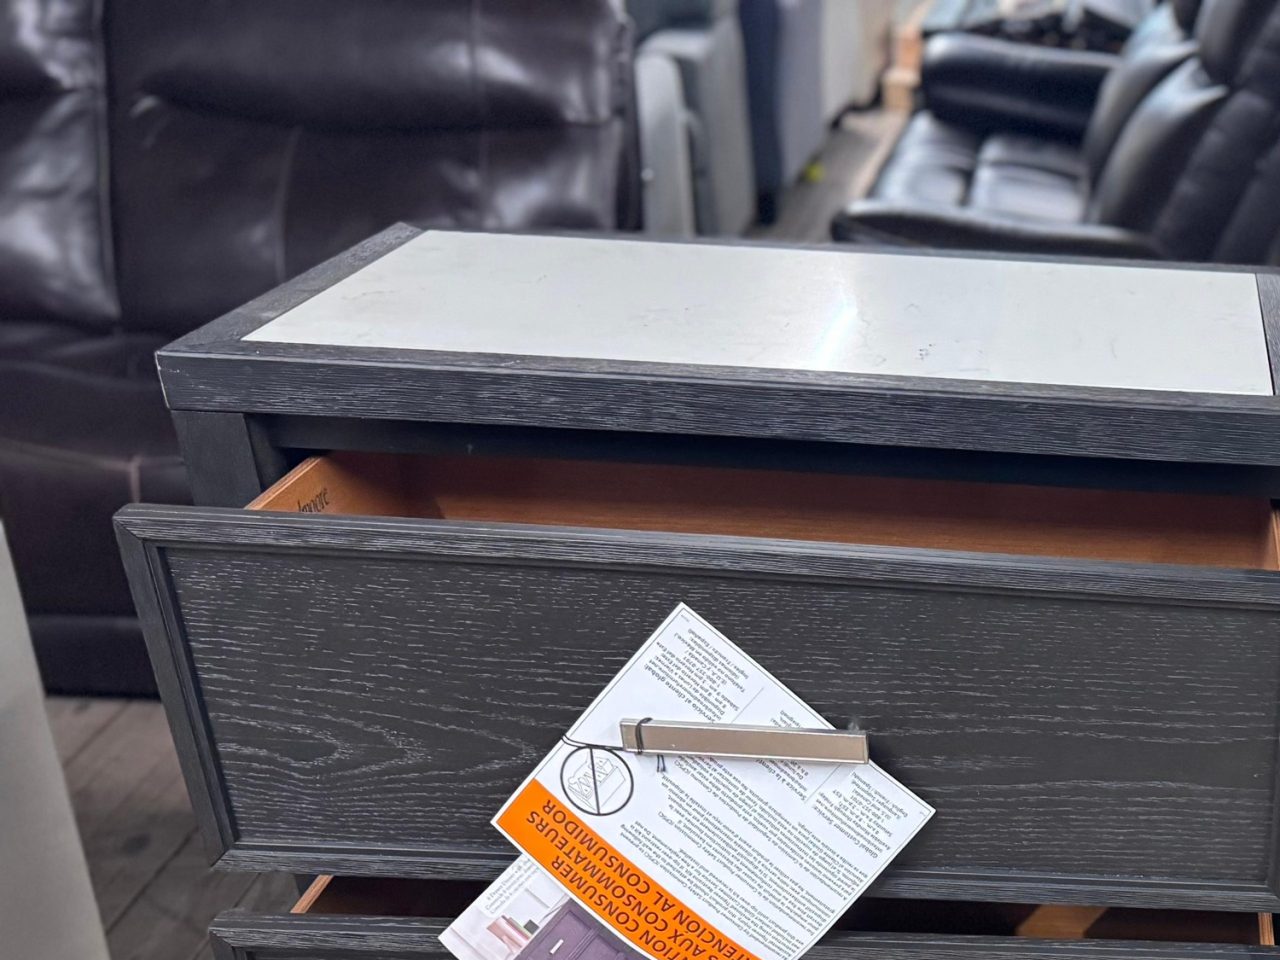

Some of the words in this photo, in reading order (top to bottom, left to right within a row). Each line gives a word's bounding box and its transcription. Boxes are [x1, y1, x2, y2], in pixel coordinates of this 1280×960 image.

[524, 808, 670, 935] CONSOMMATEURS
[540, 799, 652, 897] CONSUMIDOR
[549, 854, 641, 935] CONSUMER
[648, 889, 676, 915] AL
[666, 927, 706, 959] AUX
